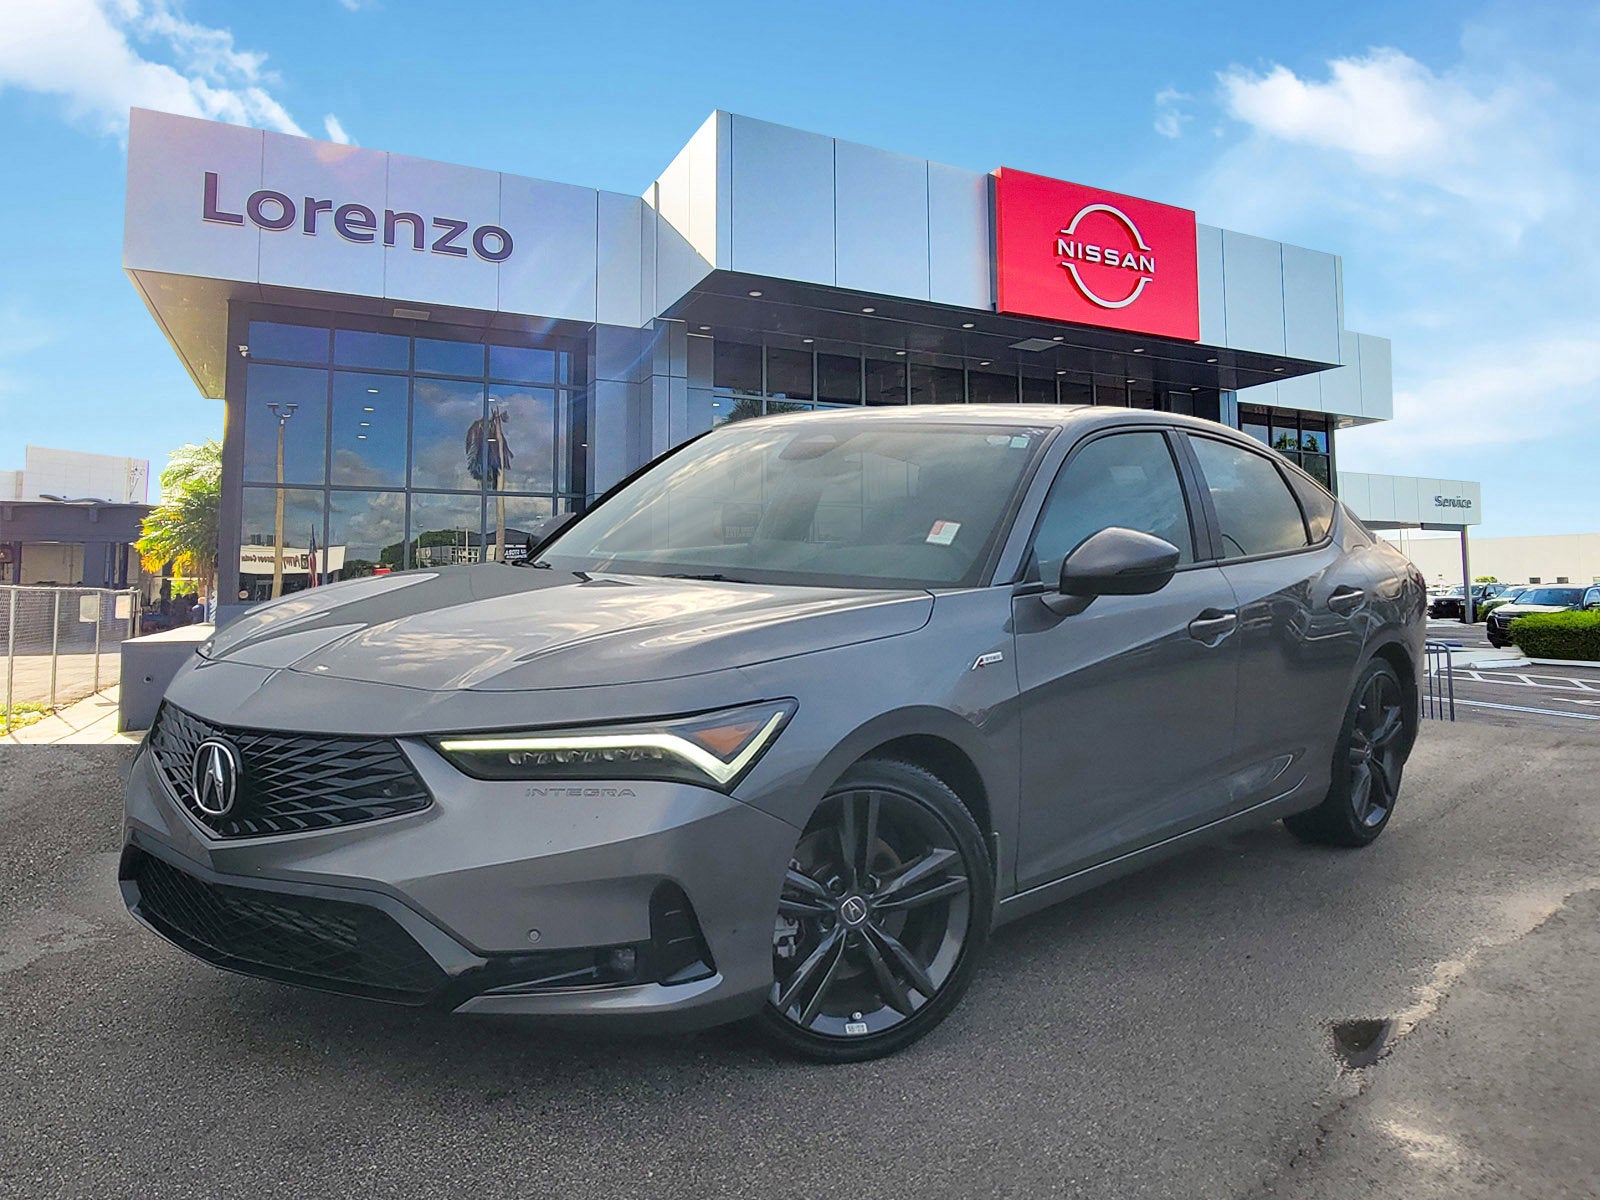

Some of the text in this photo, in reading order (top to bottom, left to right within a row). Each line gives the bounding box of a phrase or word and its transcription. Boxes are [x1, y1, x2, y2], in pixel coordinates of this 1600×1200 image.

[203, 171, 514, 262] Lorenzo
[1057, 238, 1155, 273] NISSAN
[1434, 495, 1472, 508] Service
[525, 787, 636, 798] INTEGRA
